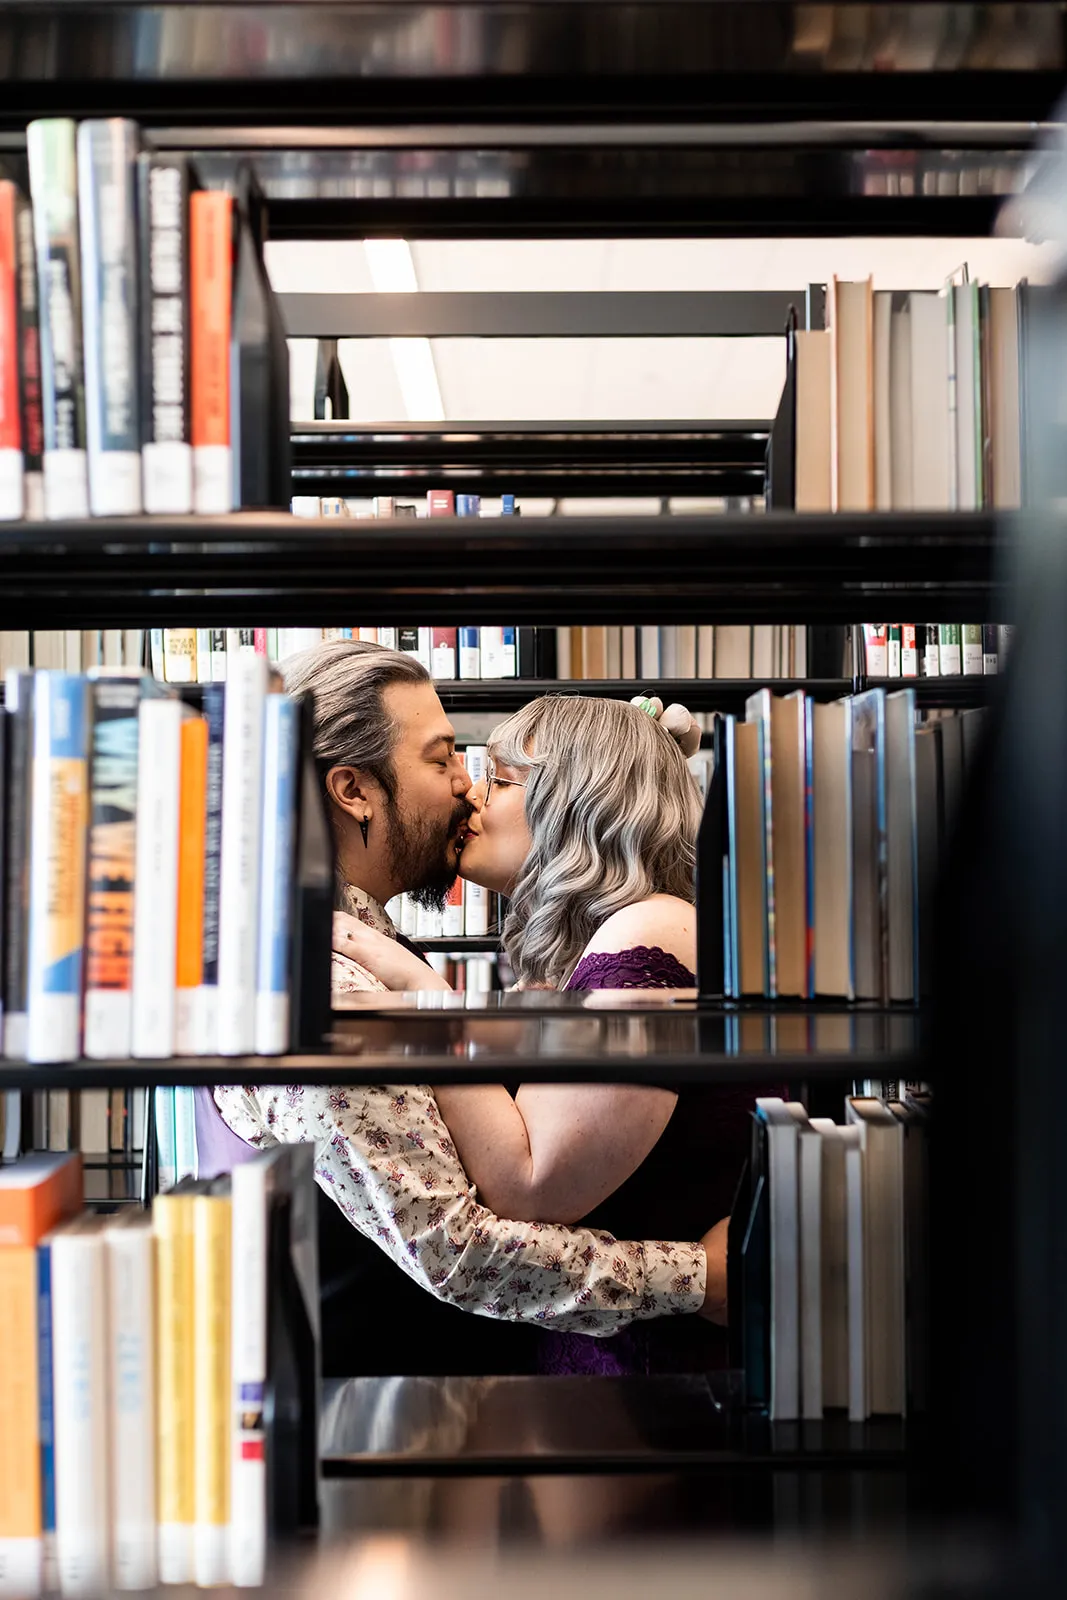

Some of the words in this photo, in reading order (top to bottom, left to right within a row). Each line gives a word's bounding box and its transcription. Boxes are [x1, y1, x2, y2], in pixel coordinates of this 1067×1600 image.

[93, 717, 139, 813] WHY
[90, 820, 136, 882] WE
[87, 890, 133, 990] FIGHT
